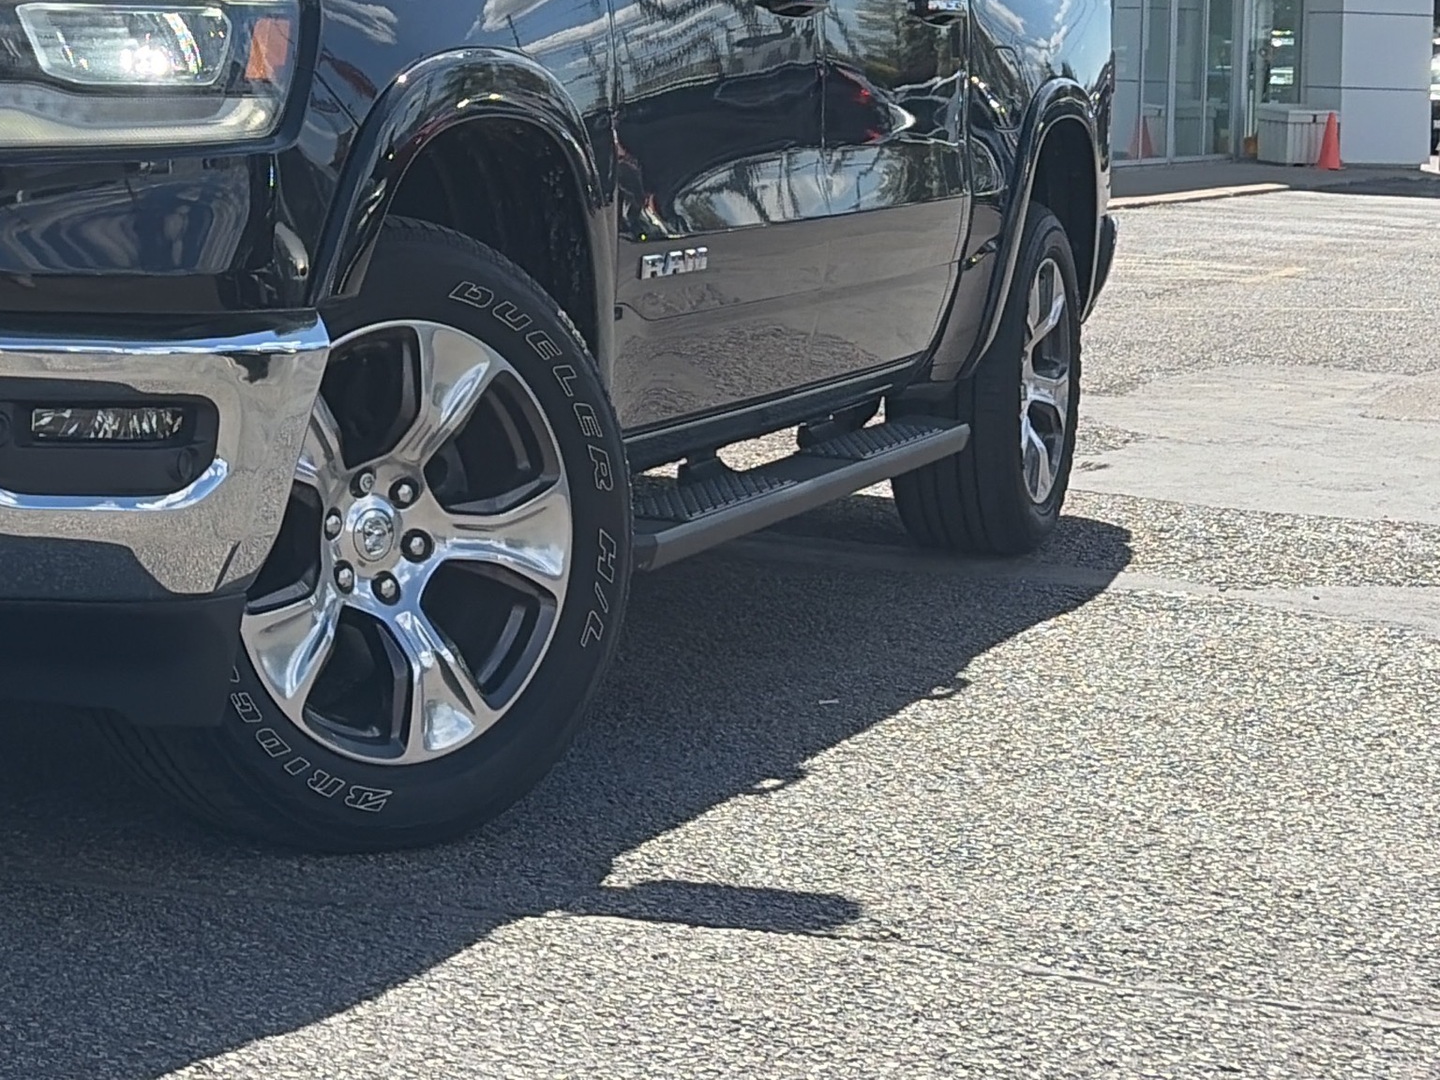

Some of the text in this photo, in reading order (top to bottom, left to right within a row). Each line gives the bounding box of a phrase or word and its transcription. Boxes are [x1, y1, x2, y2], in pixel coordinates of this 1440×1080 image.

[640, 246, 709, 280] RAM
[448, 280, 617, 648] DUELER H/L
[229, 666, 393, 812] BRIDG
